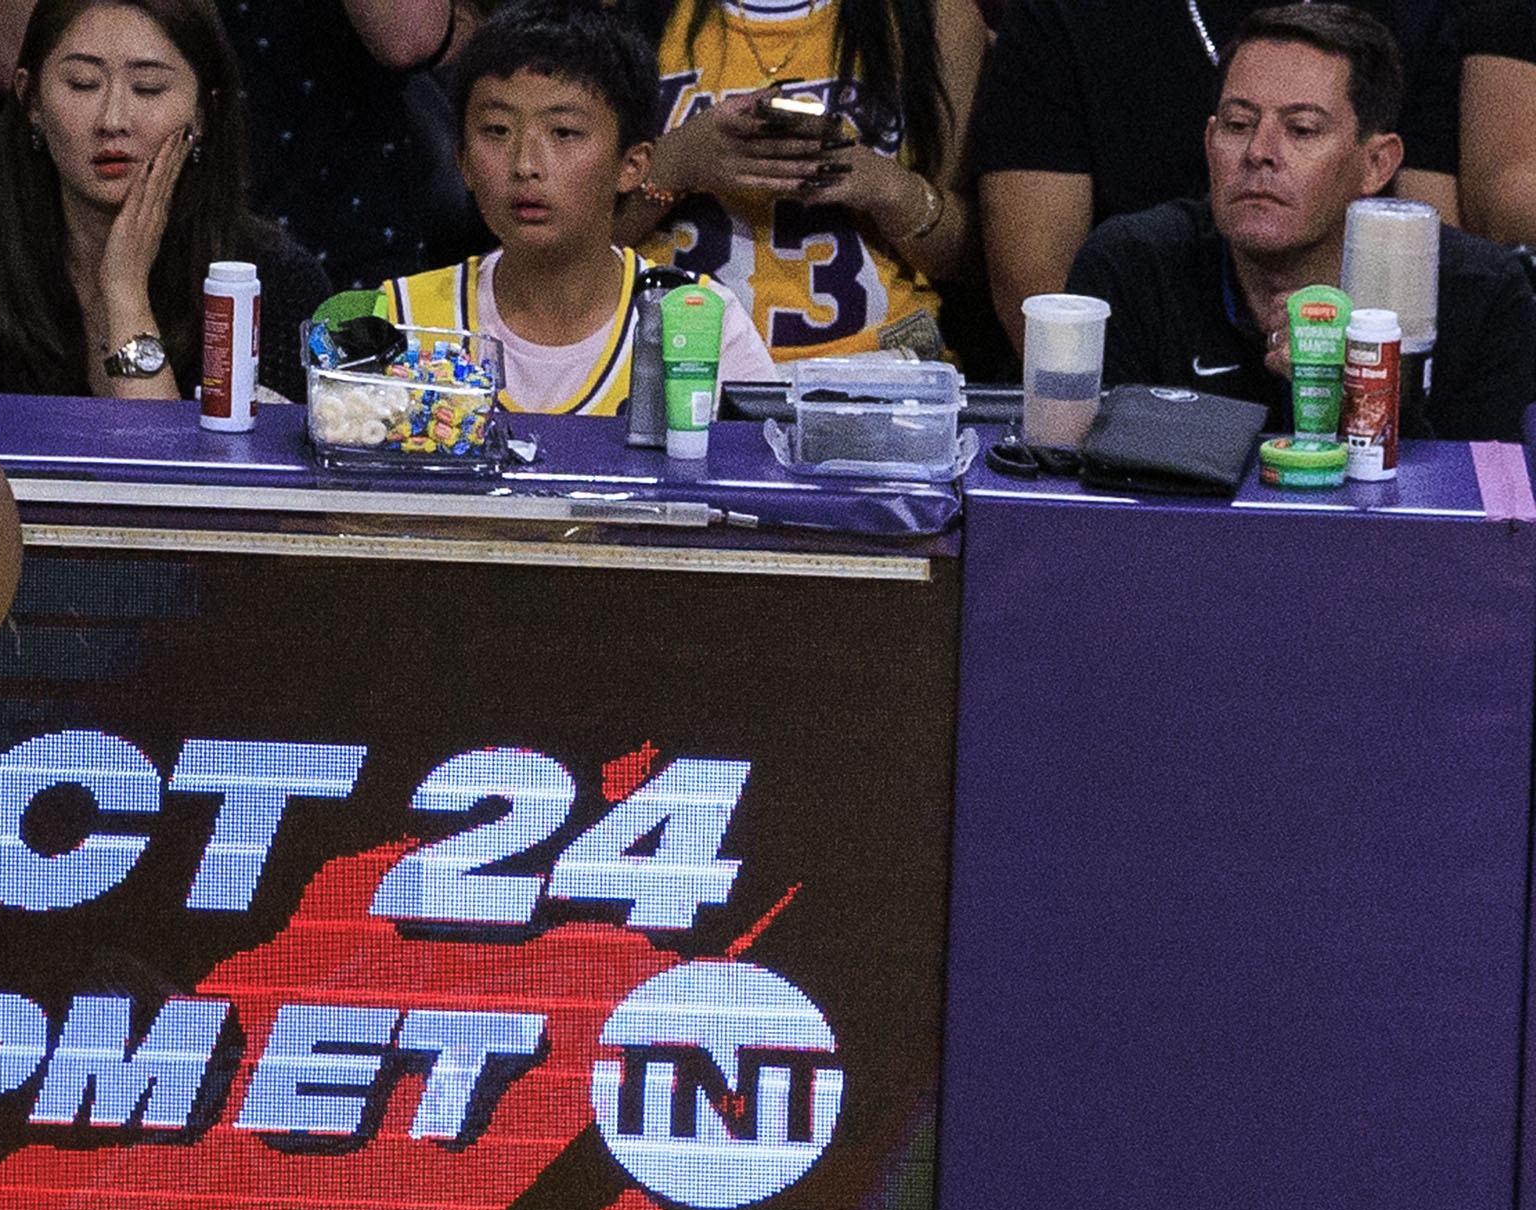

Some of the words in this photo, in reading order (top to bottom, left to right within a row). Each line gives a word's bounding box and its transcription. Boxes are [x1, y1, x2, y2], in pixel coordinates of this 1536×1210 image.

[369, 746, 752, 929] 24
[232, 1004, 548, 1140] ET
[592, 1043, 844, 1144] TNT
